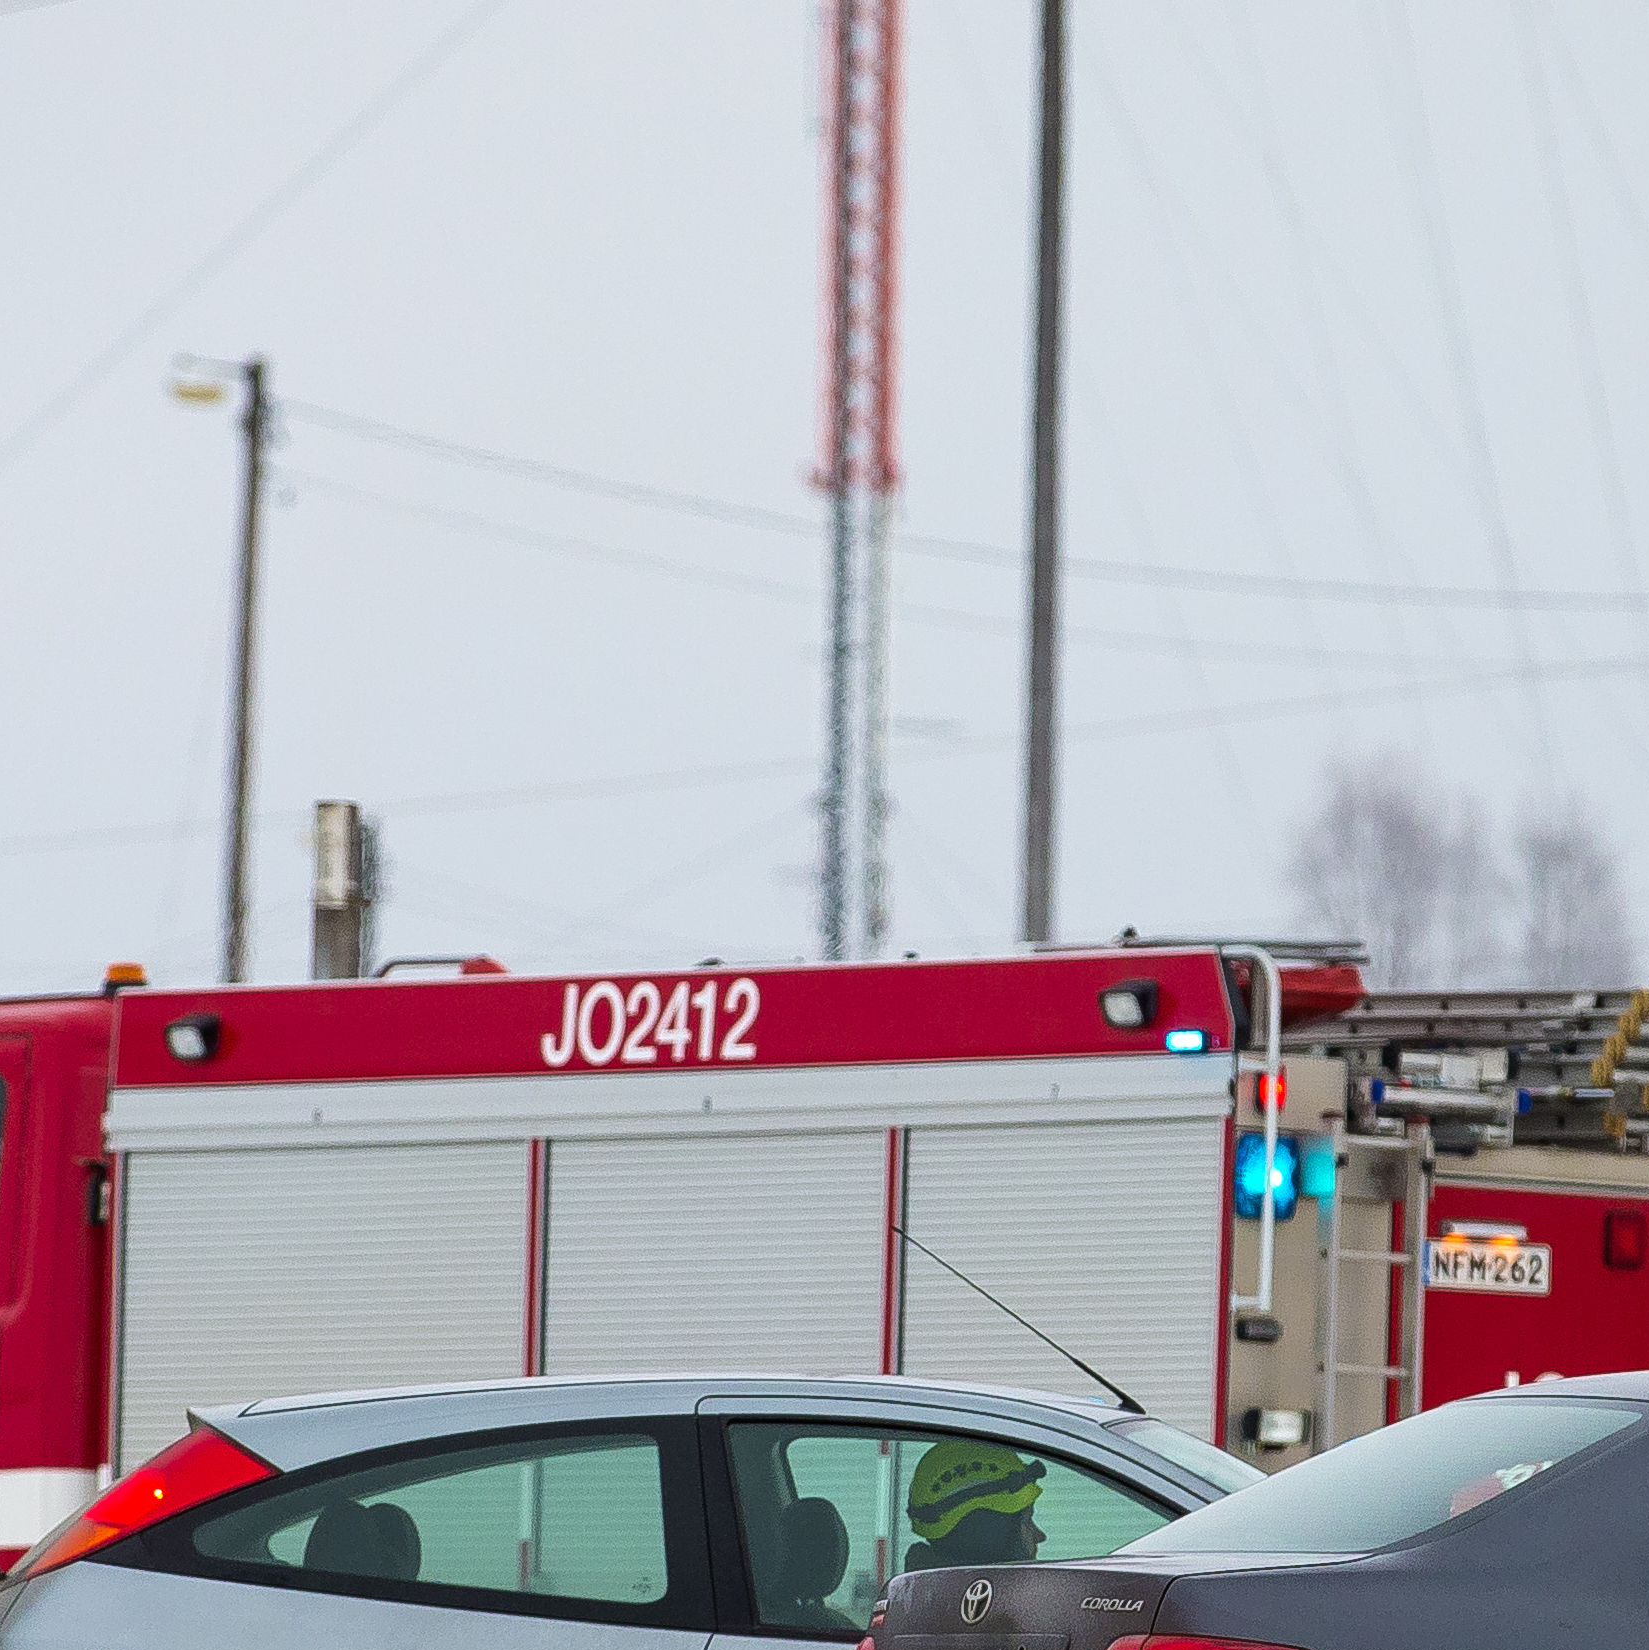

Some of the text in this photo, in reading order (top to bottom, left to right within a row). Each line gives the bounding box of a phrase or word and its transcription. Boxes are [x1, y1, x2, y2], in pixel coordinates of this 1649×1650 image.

[540, 977, 761, 1068] JO2412
[1435, 1250, 1543, 1285] NFM-262
[1081, 1596, 1145, 1612] COROLLA
